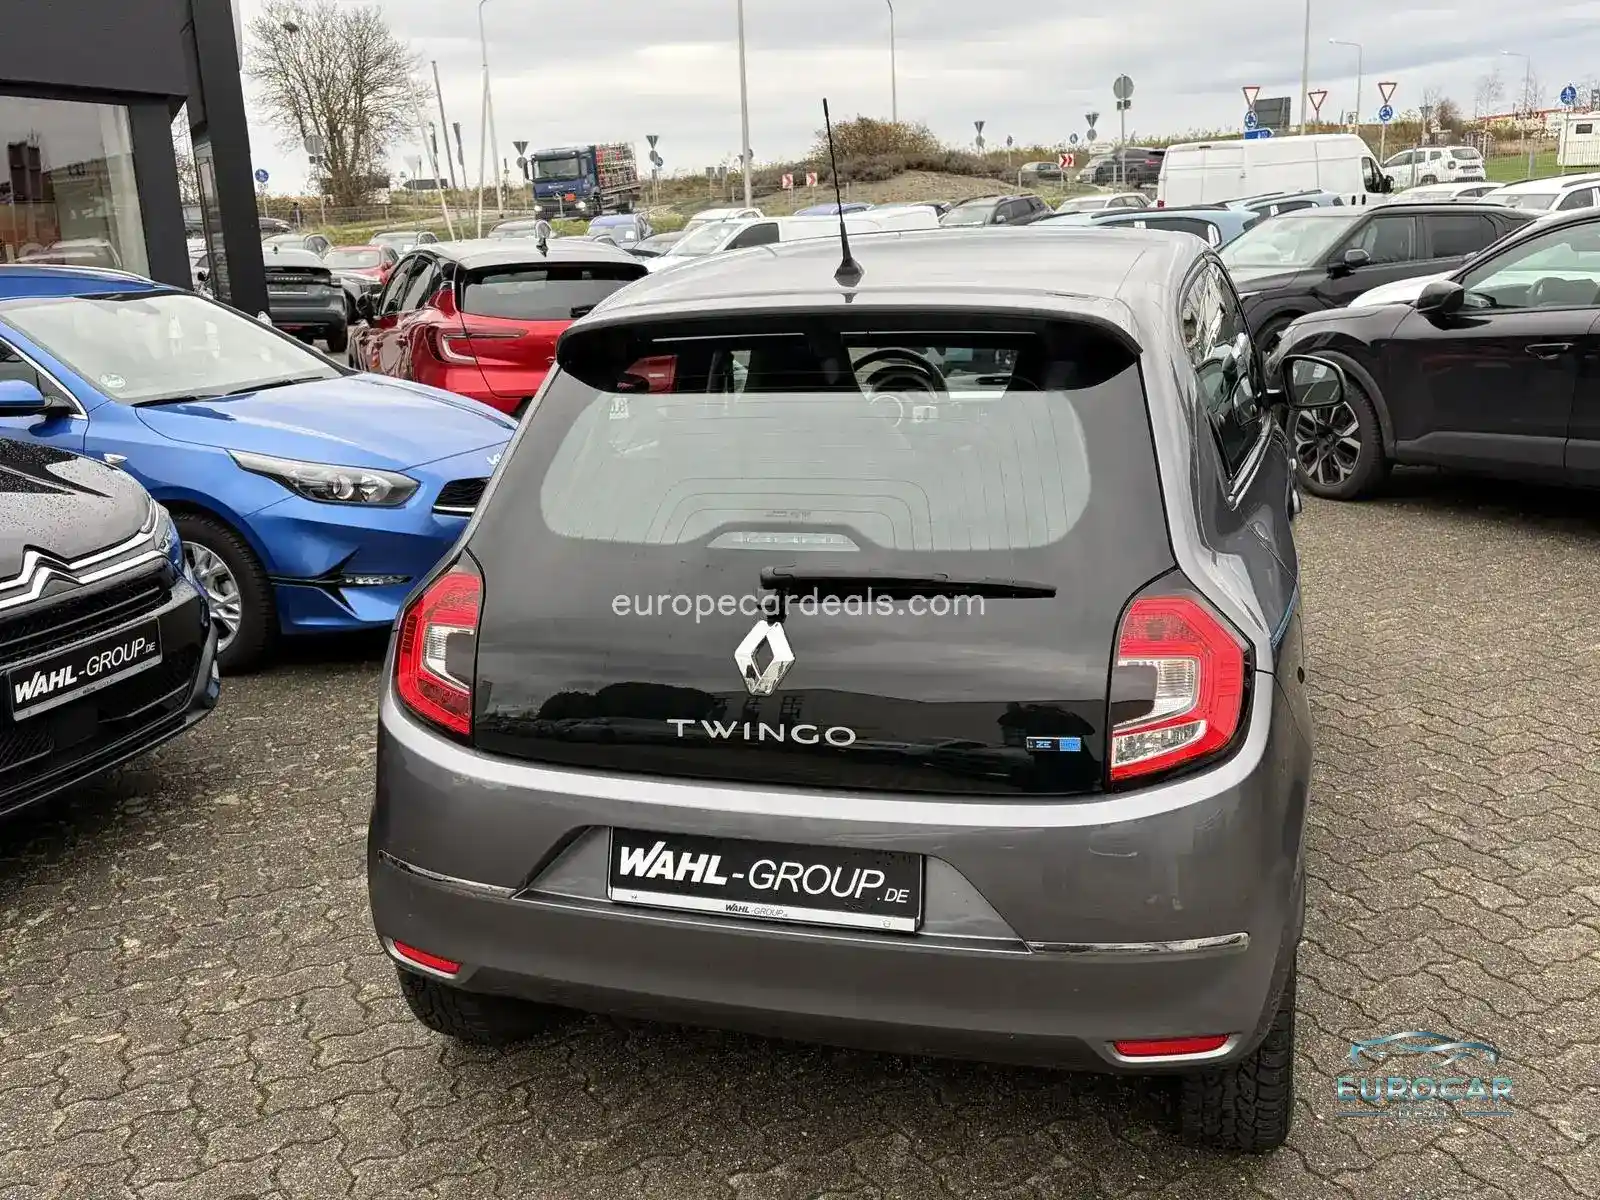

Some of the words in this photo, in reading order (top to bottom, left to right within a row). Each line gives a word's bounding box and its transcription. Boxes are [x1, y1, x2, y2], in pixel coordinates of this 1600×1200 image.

[15, 637, 156, 704] WAHL-GROUP.DE
[666, 718, 857, 748] TWINGO
[619, 841, 910, 904] WAHL-GROUP.DE
